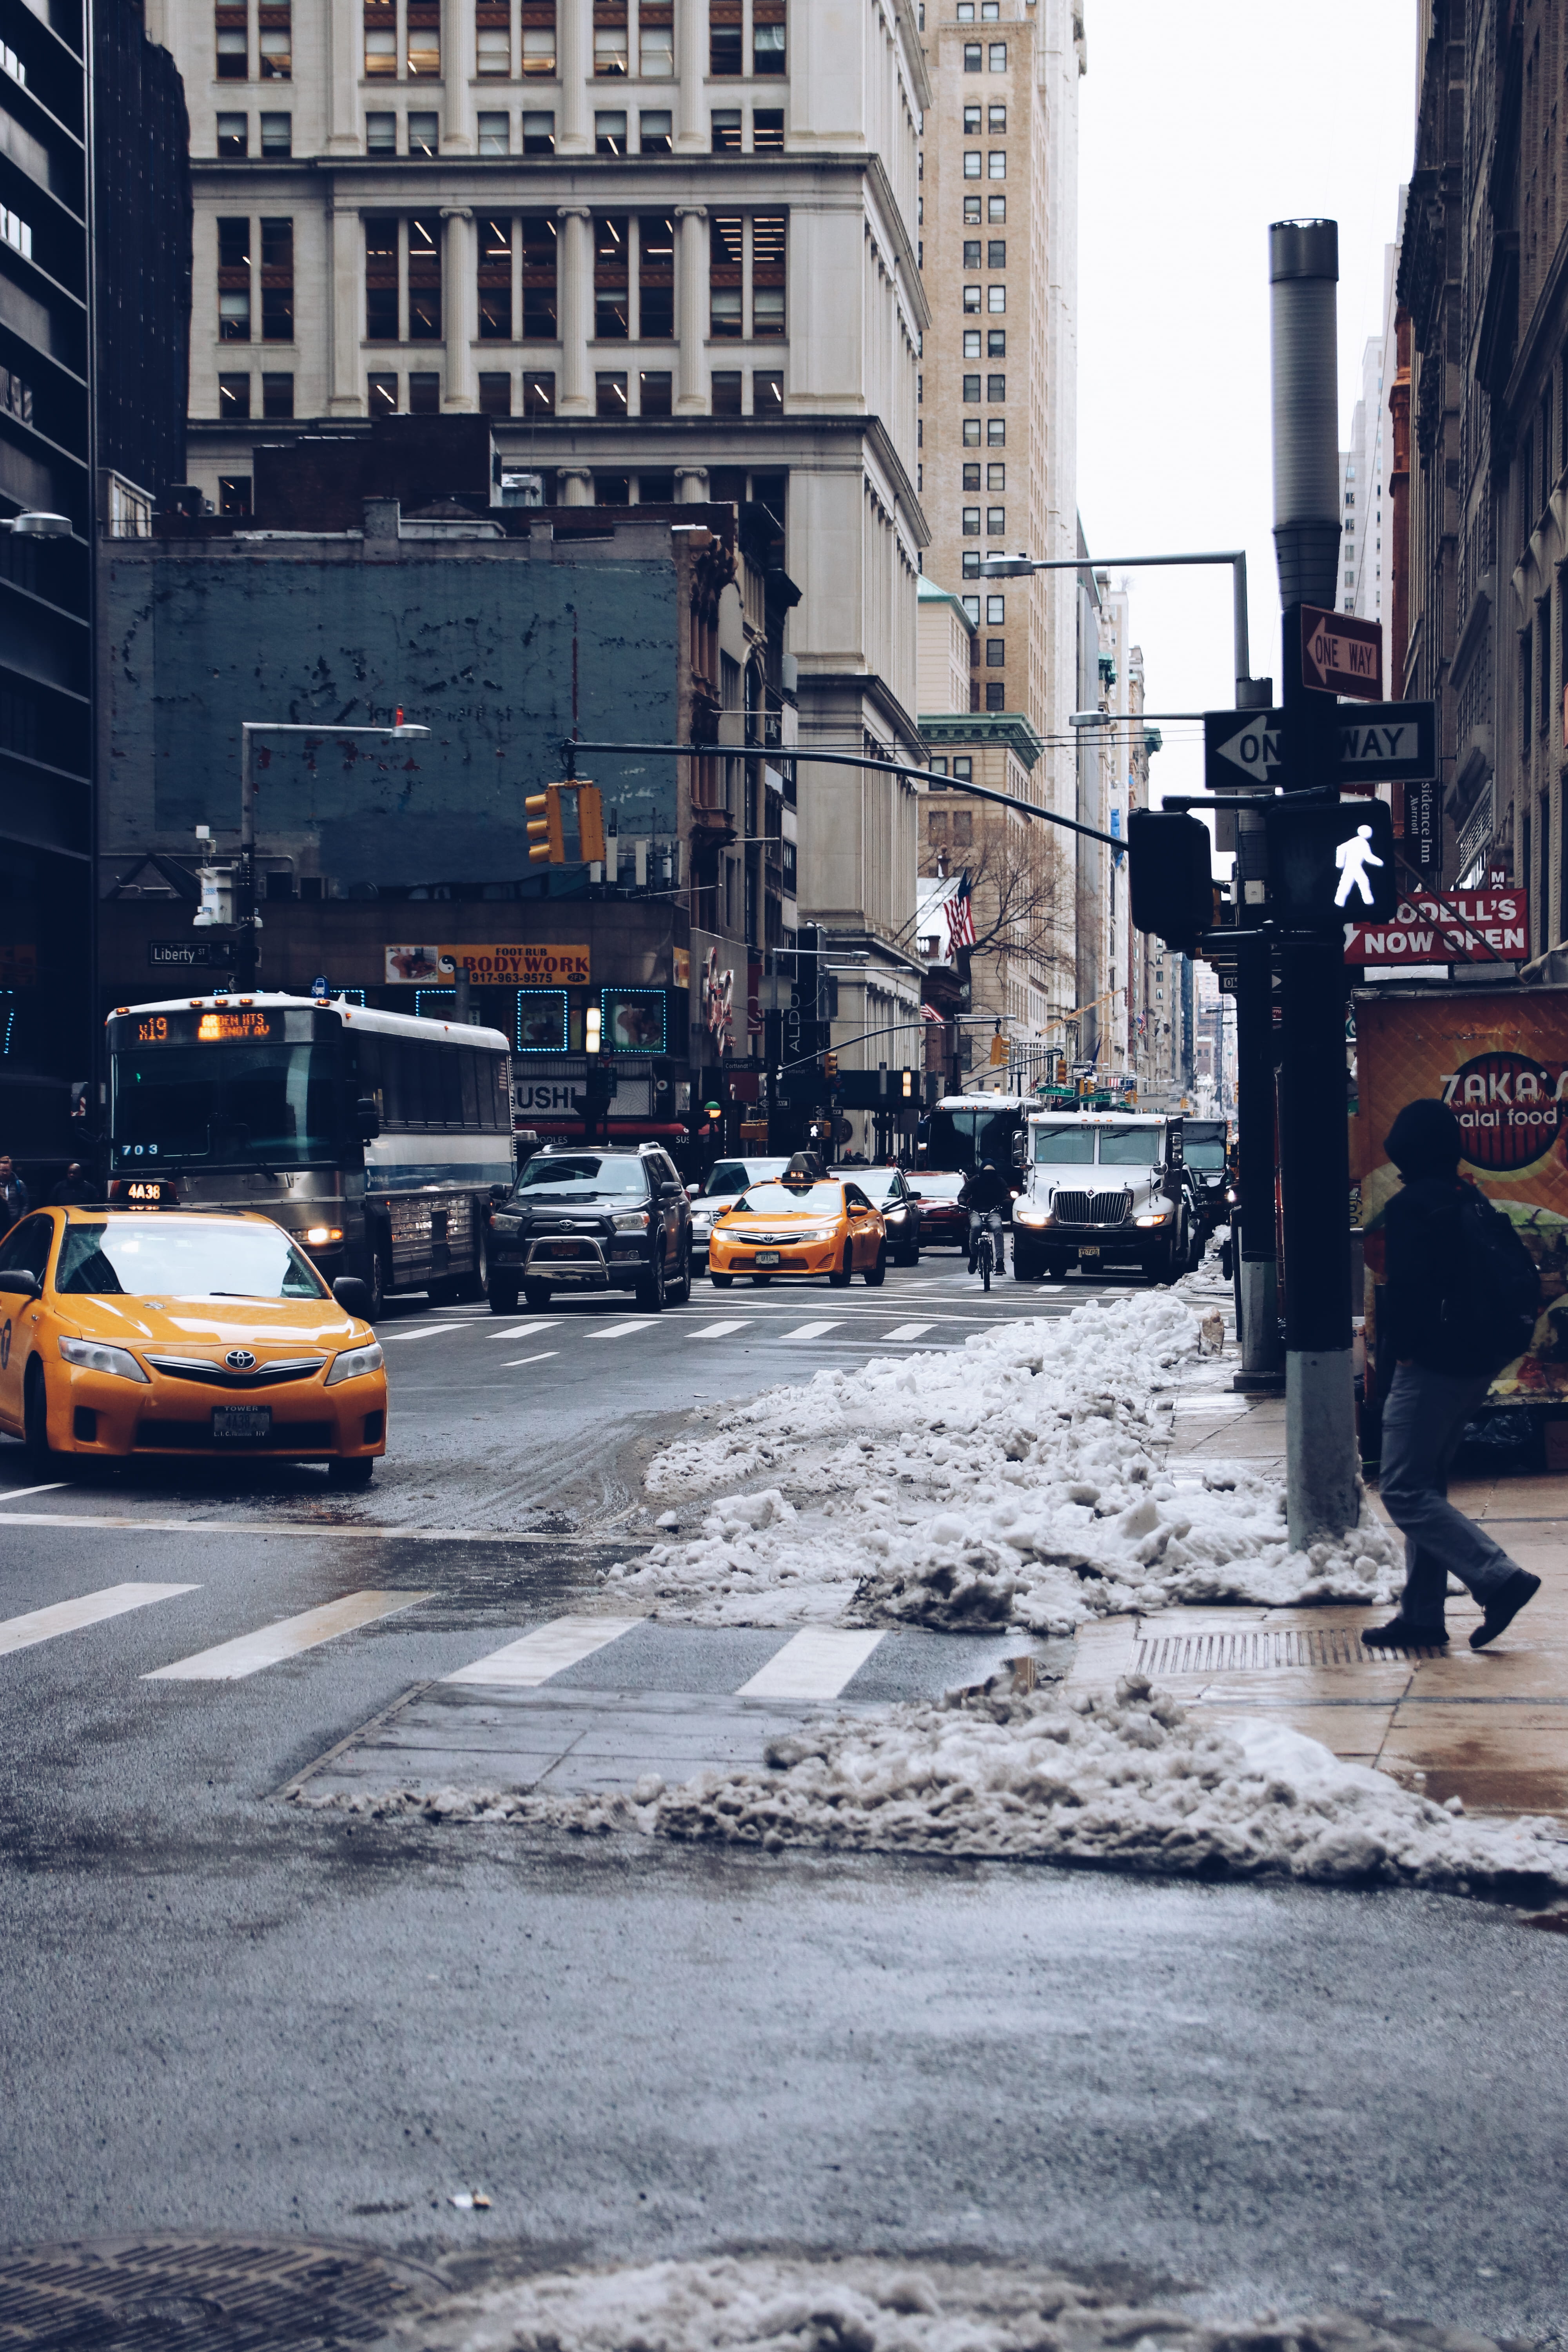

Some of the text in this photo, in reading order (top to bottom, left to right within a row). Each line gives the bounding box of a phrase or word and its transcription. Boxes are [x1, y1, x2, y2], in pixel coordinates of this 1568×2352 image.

[1316, 635, 1372, 675] ONE WAY
[1240, 734, 1281, 764] ON
[1410, 795, 1419, 834] Marriott
[1421, 782, 1432, 864] sidence Inn
[1388, 899, 1517, 924] ODELL'S
[1365, 928, 1524, 954] NOW OPEN
[154, 948, 195, 964] Liberty
[496, 948, 547, 956] FOOT RUB
[463, 956, 590, 973] BODYWORK
[472, 973, 552, 983] 917-963-9575
[242, 1013, 264, 1025] HTS
[789, 993, 800, 1053] ALDO
[513, 1087, 576, 1109] USHI
[1455, 1107, 1557, 1127] alal food
[122, 1144, 158, 1156] 703
[536, 1136, 568, 1144] ODLES
[128, 1183, 160, 1200] 4A38
